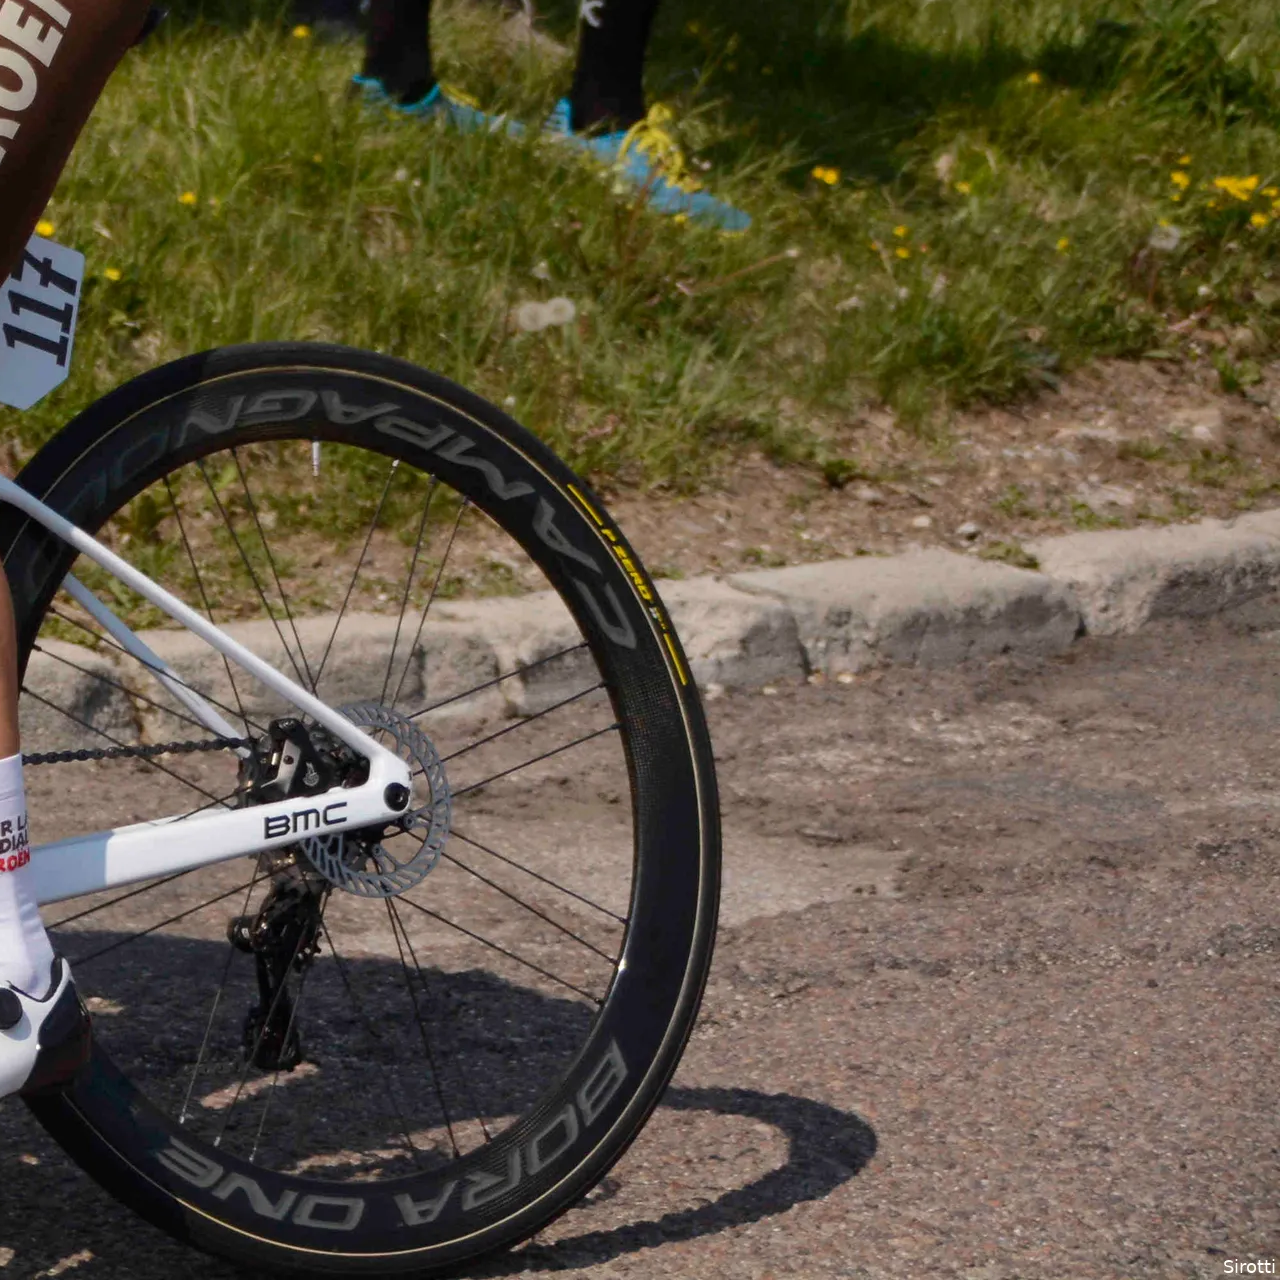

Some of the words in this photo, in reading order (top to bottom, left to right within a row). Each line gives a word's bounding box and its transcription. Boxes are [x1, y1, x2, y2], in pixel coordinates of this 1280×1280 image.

[2, 248, 78, 368] 117
[612, 544, 654, 602] ZERO
[264, 802, 348, 840] BMC
[393, 1038, 628, 1228] BORA
[155, 1135, 365, 1232] ONE
